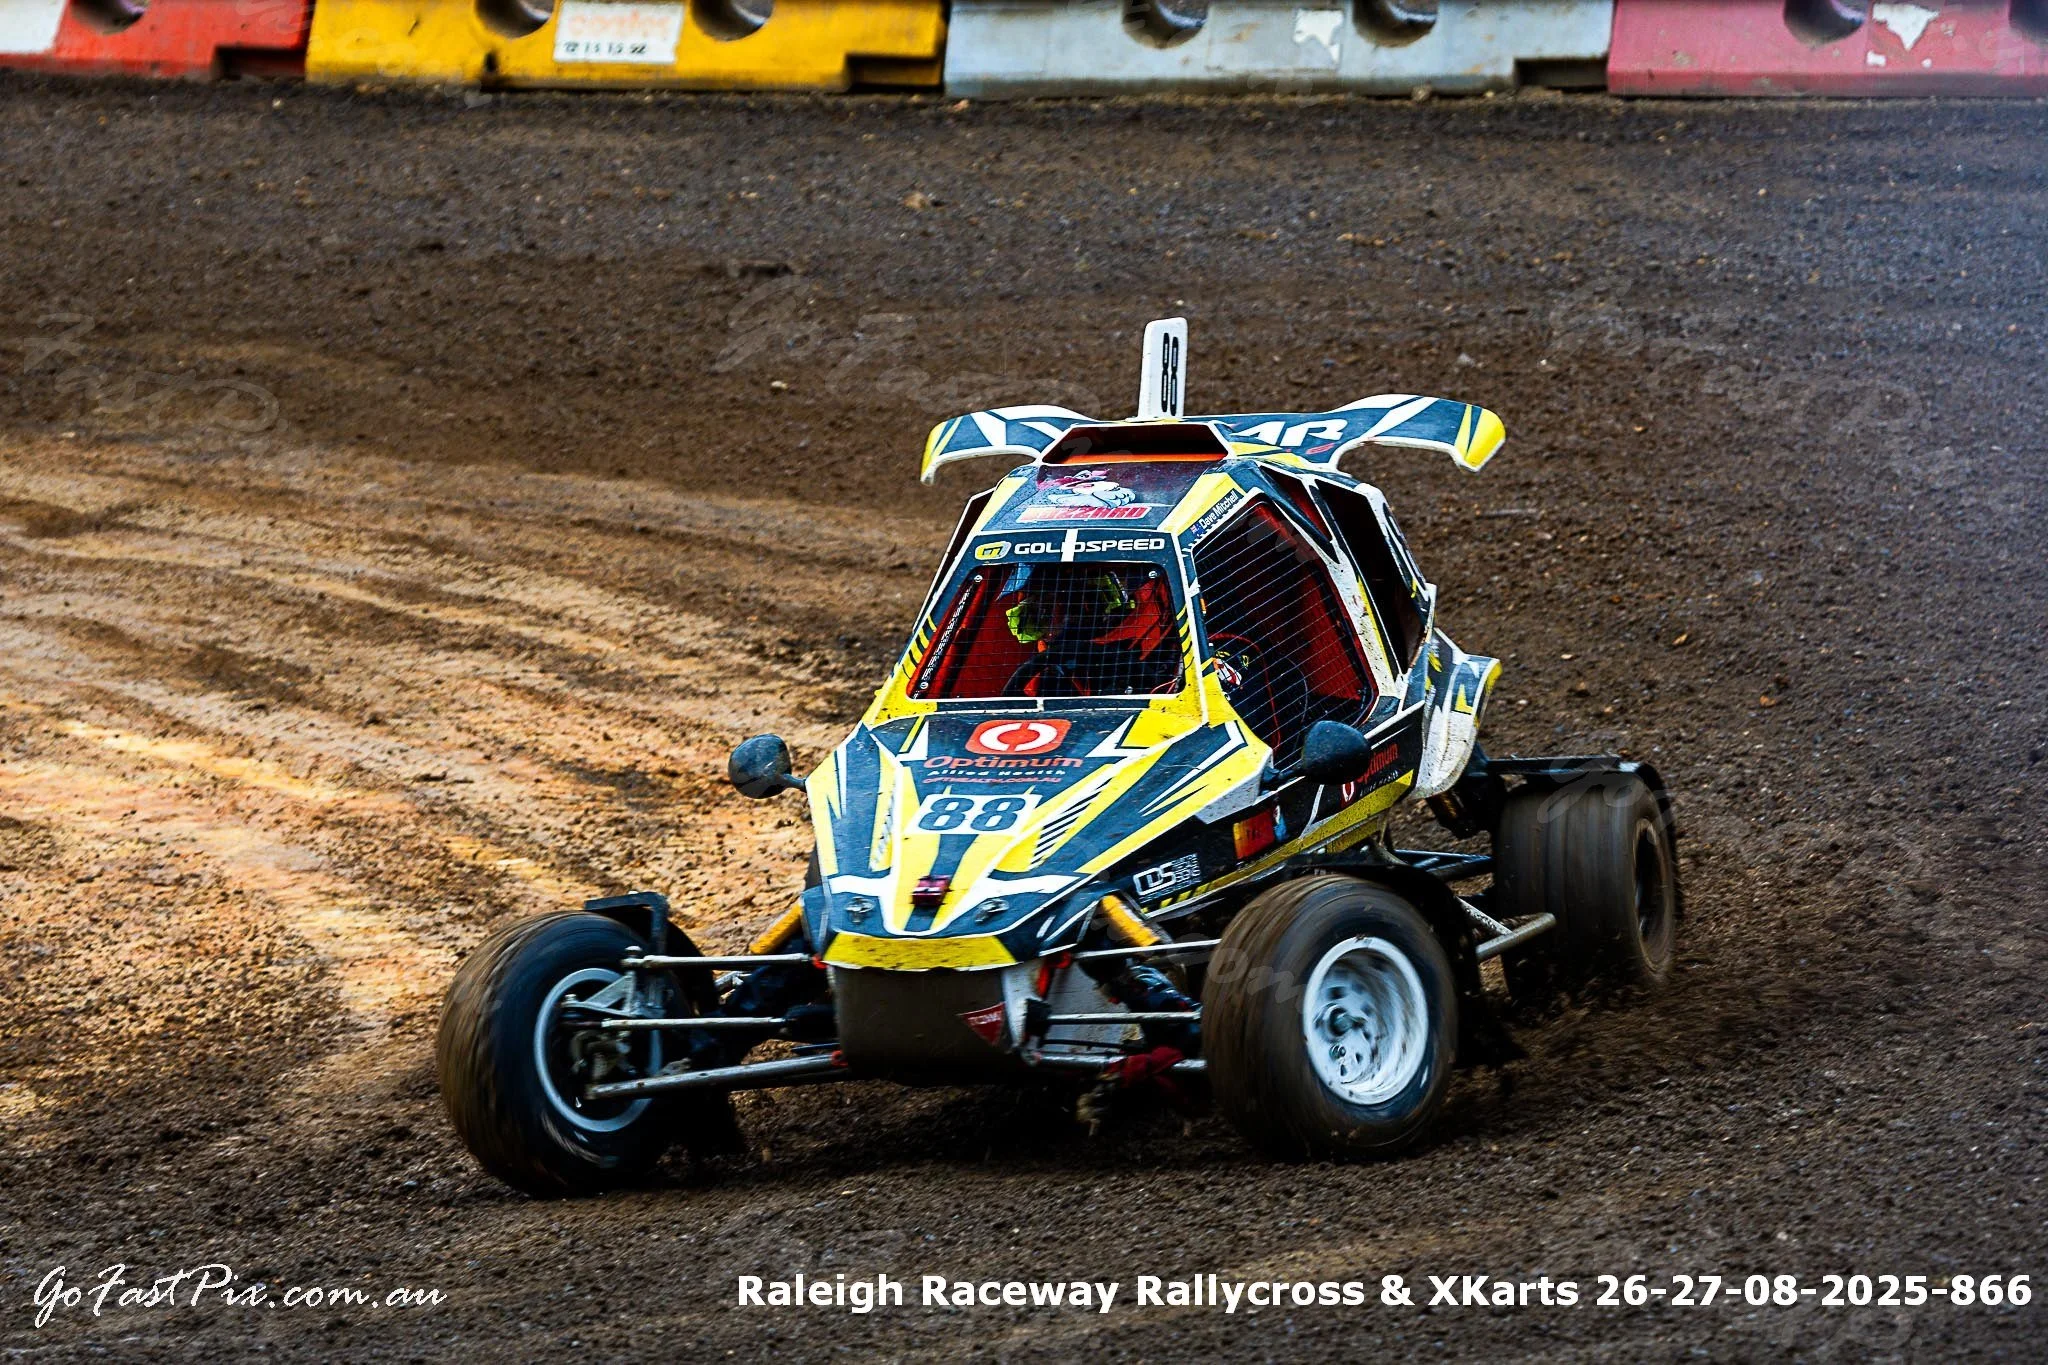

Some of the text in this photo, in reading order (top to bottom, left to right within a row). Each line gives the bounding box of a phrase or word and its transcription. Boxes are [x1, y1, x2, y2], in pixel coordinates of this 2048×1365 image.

[1161, 332, 1179, 417] 88
[1199, 489, 1239, 530] Dave Mitchell
[1014, 538, 1165, 555] GOLDSPEED
[923, 756, 1083, 768] Optimum
[918, 797, 1026, 832] 88
